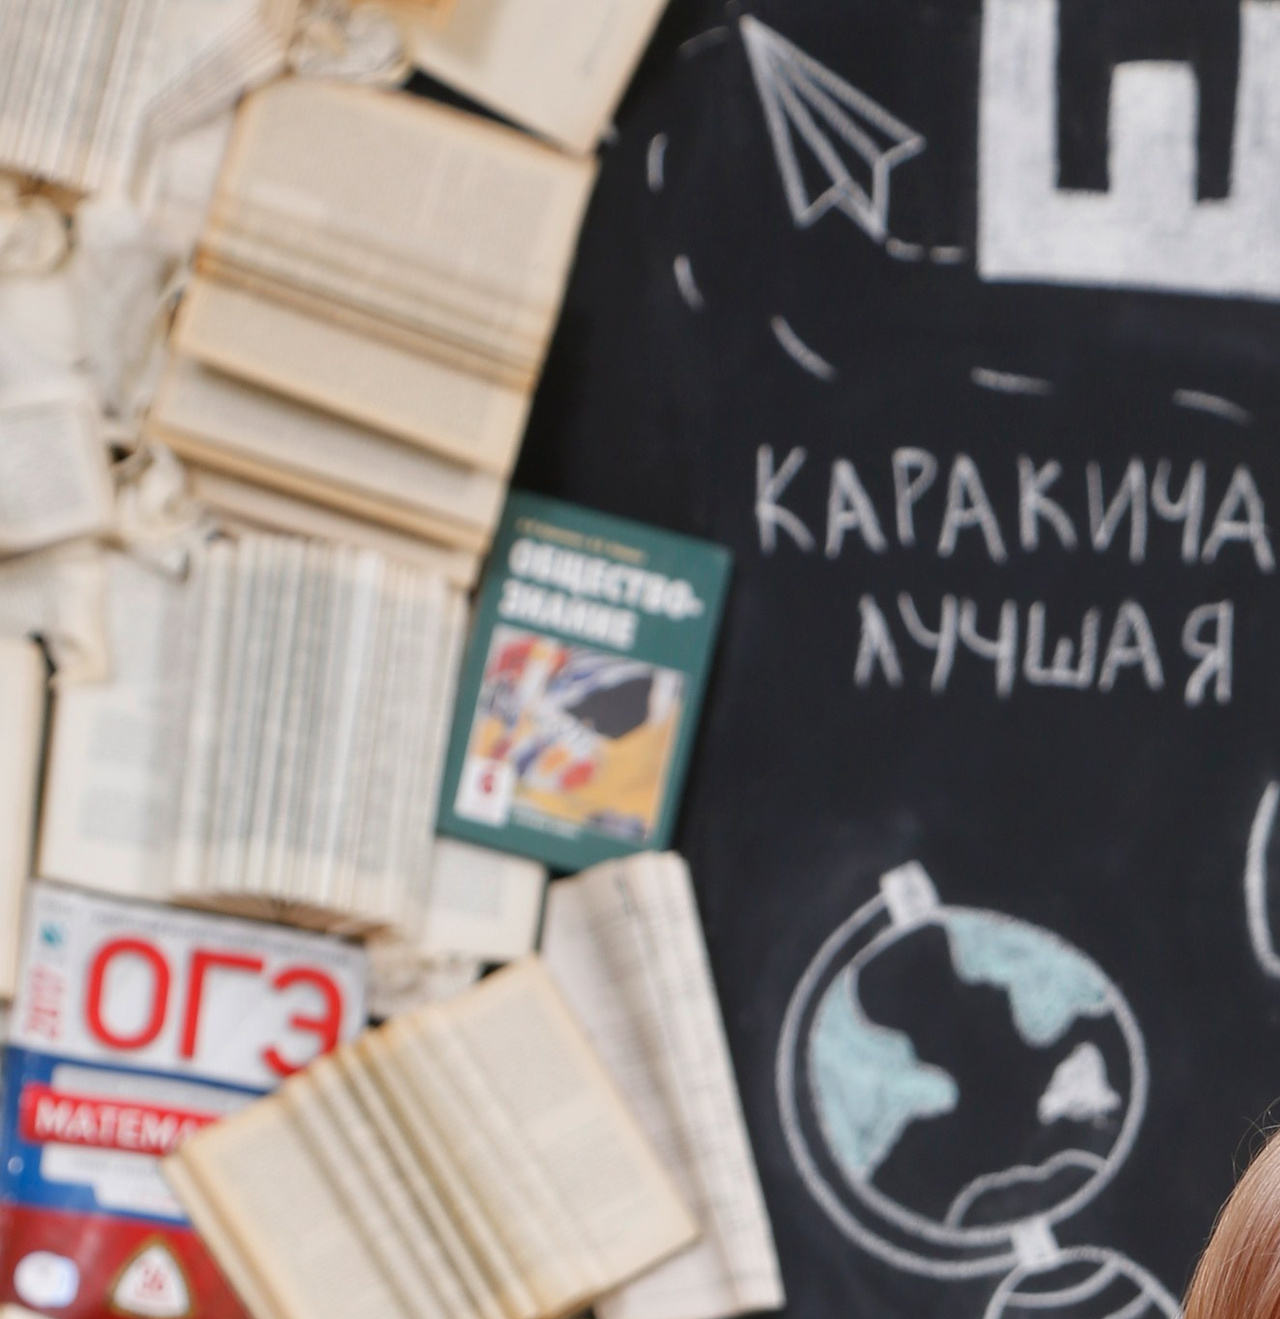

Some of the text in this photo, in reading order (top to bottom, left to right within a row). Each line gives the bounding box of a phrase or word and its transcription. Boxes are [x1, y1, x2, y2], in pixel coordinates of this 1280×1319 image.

[755, 446, 1274, 571] КАРАКИЧА
[855, 594, 1233, 704] ЛУЧШАЯ
[82, 935, 348, 1078] ОГЭ
